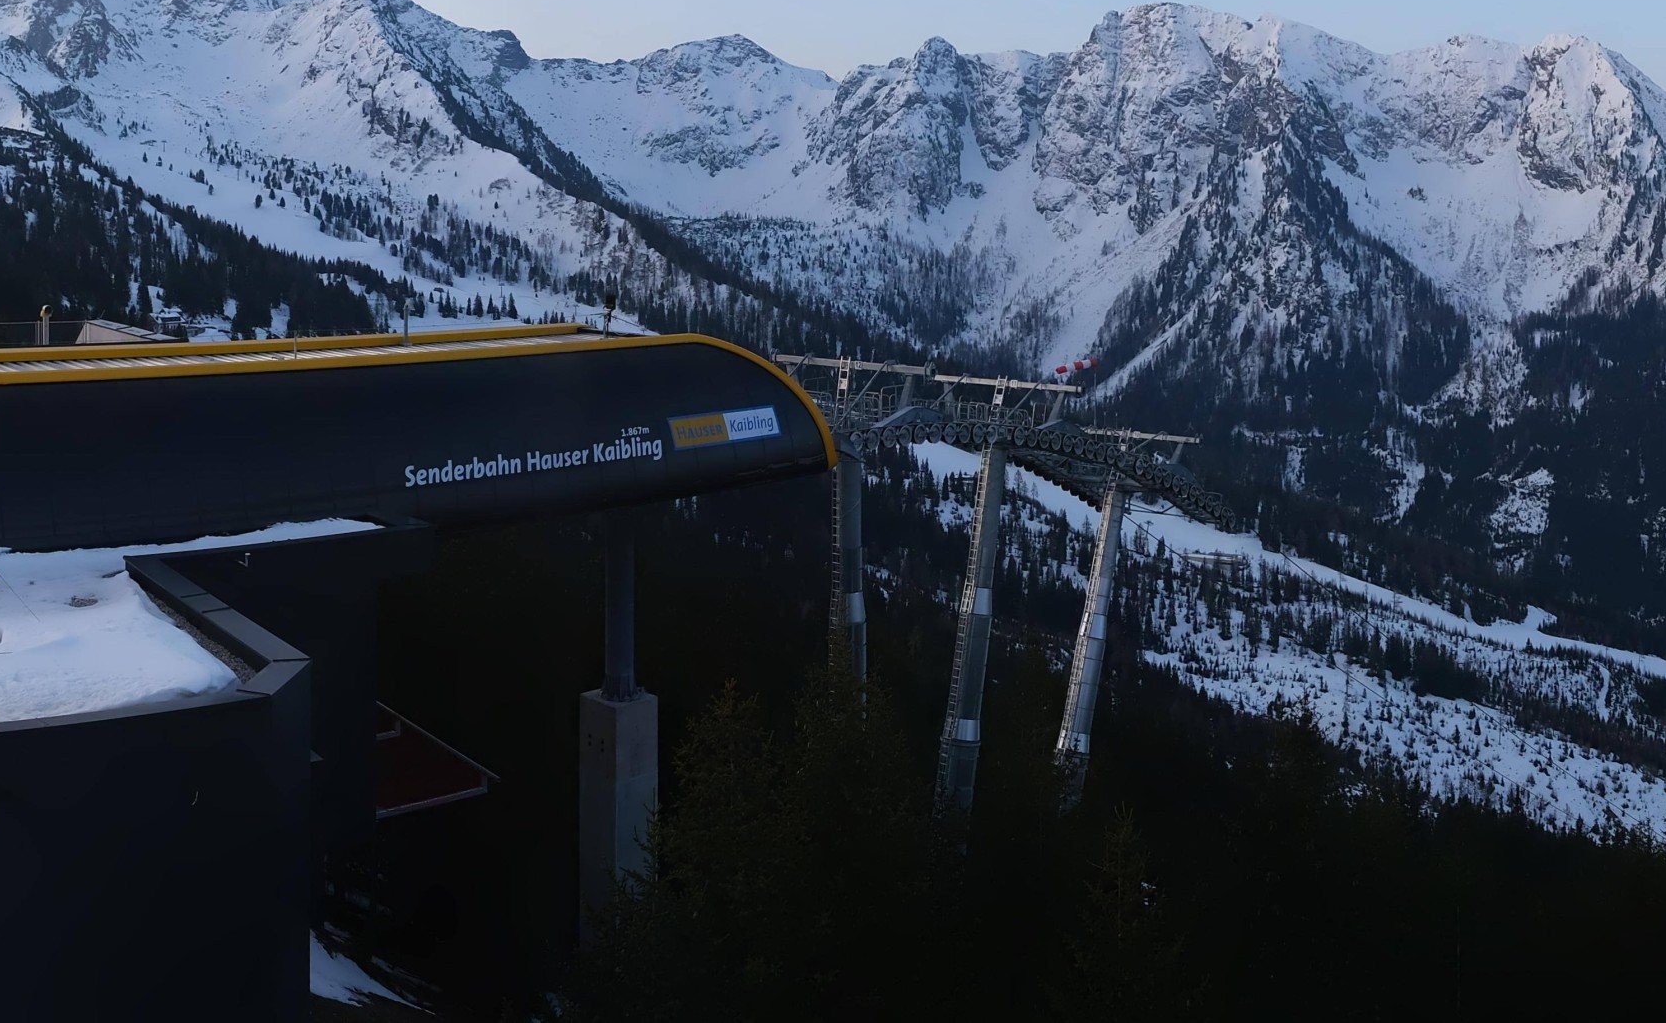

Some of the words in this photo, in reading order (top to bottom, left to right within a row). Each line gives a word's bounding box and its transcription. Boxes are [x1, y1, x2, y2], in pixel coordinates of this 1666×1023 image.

[621, 426, 650, 437] 1.867m
[676, 423, 723, 439] HAUSER
[729, 416, 774, 432] Kaibling
[404, 454, 521, 487] Senderbahn
[526, 448, 589, 472] Hauser
[593, 436, 663, 460] Kaibling
